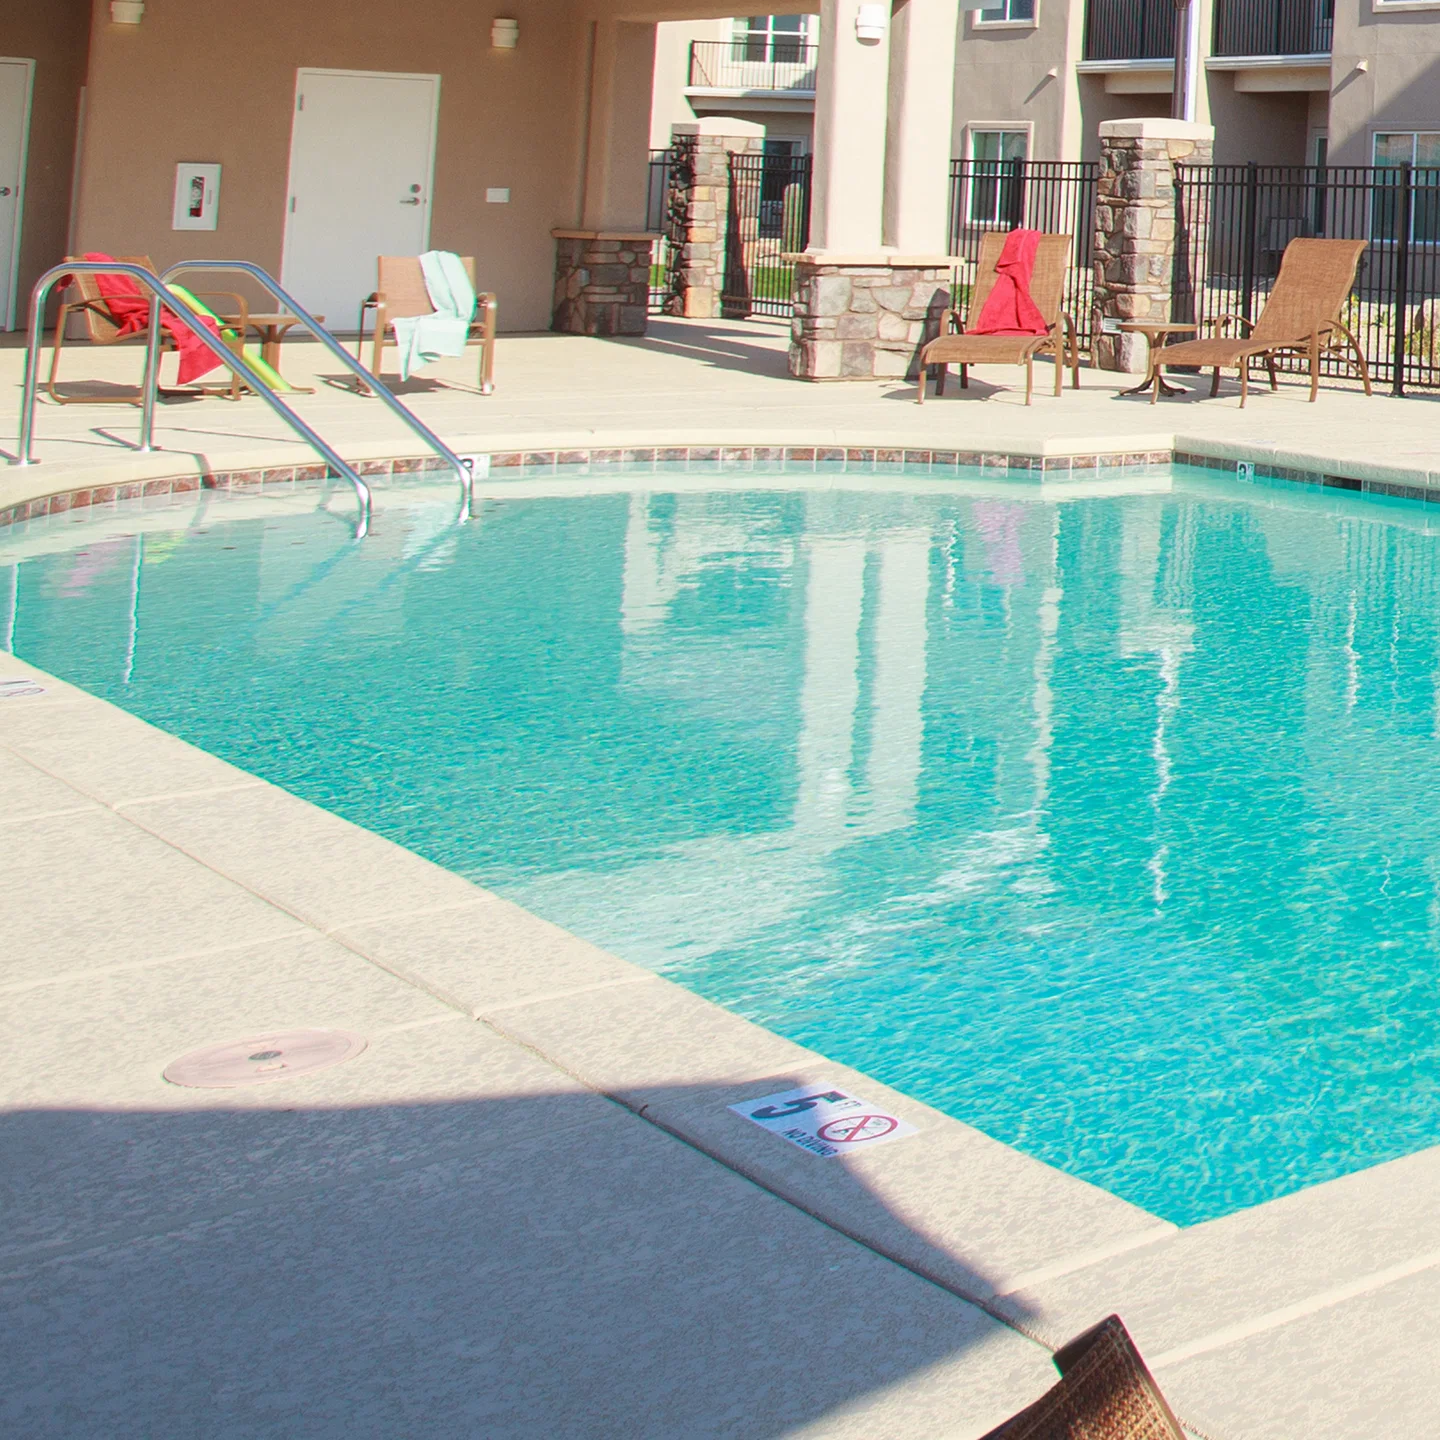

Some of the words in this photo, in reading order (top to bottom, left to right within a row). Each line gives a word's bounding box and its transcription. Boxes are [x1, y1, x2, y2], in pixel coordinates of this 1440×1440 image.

[751, 1090, 849, 1118] 5
[781, 1127, 807, 1139] NO
[796, 1135, 838, 1156] DIVING
